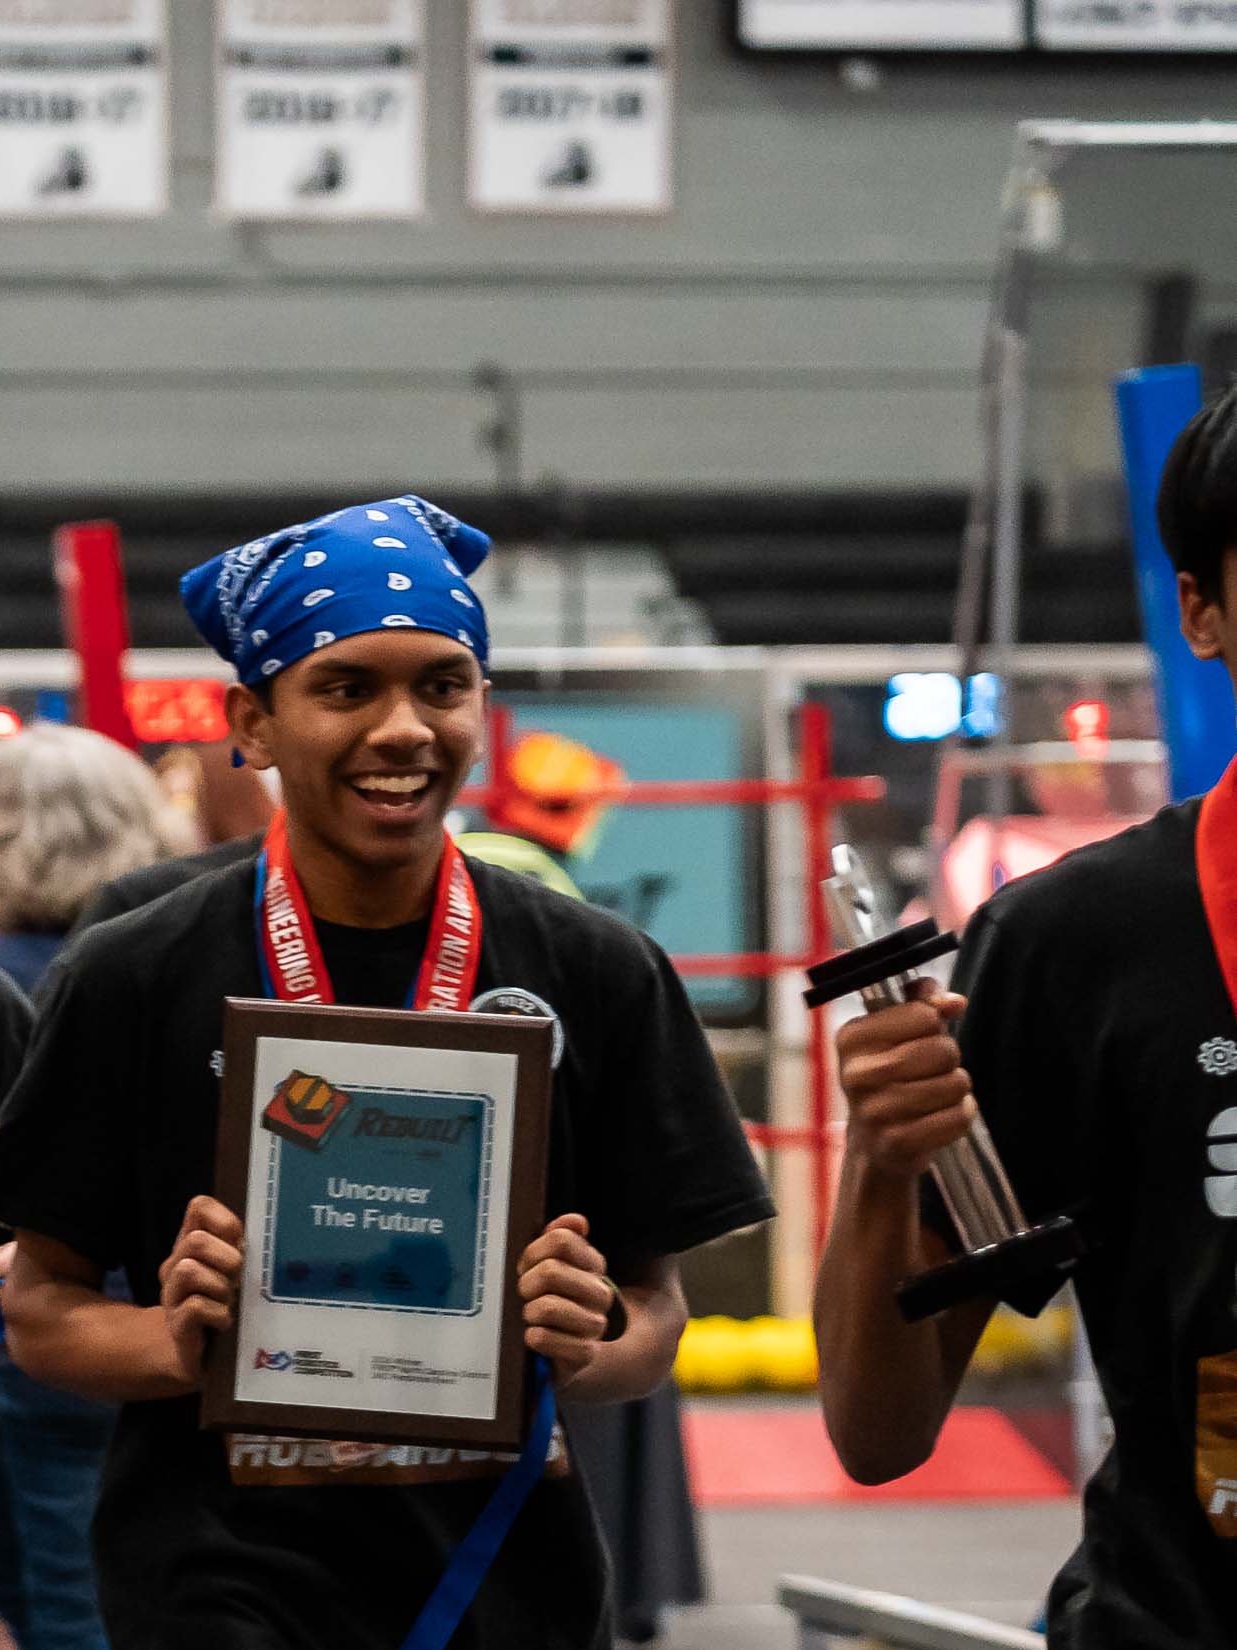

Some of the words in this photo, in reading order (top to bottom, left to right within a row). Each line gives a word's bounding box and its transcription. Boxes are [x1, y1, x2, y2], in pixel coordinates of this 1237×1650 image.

[266, 867, 318, 993] GINEERING
[327, 1177, 430, 1204] Uncover
[311, 1204, 357, 1228] The
[362, 1208, 444, 1234] Future
